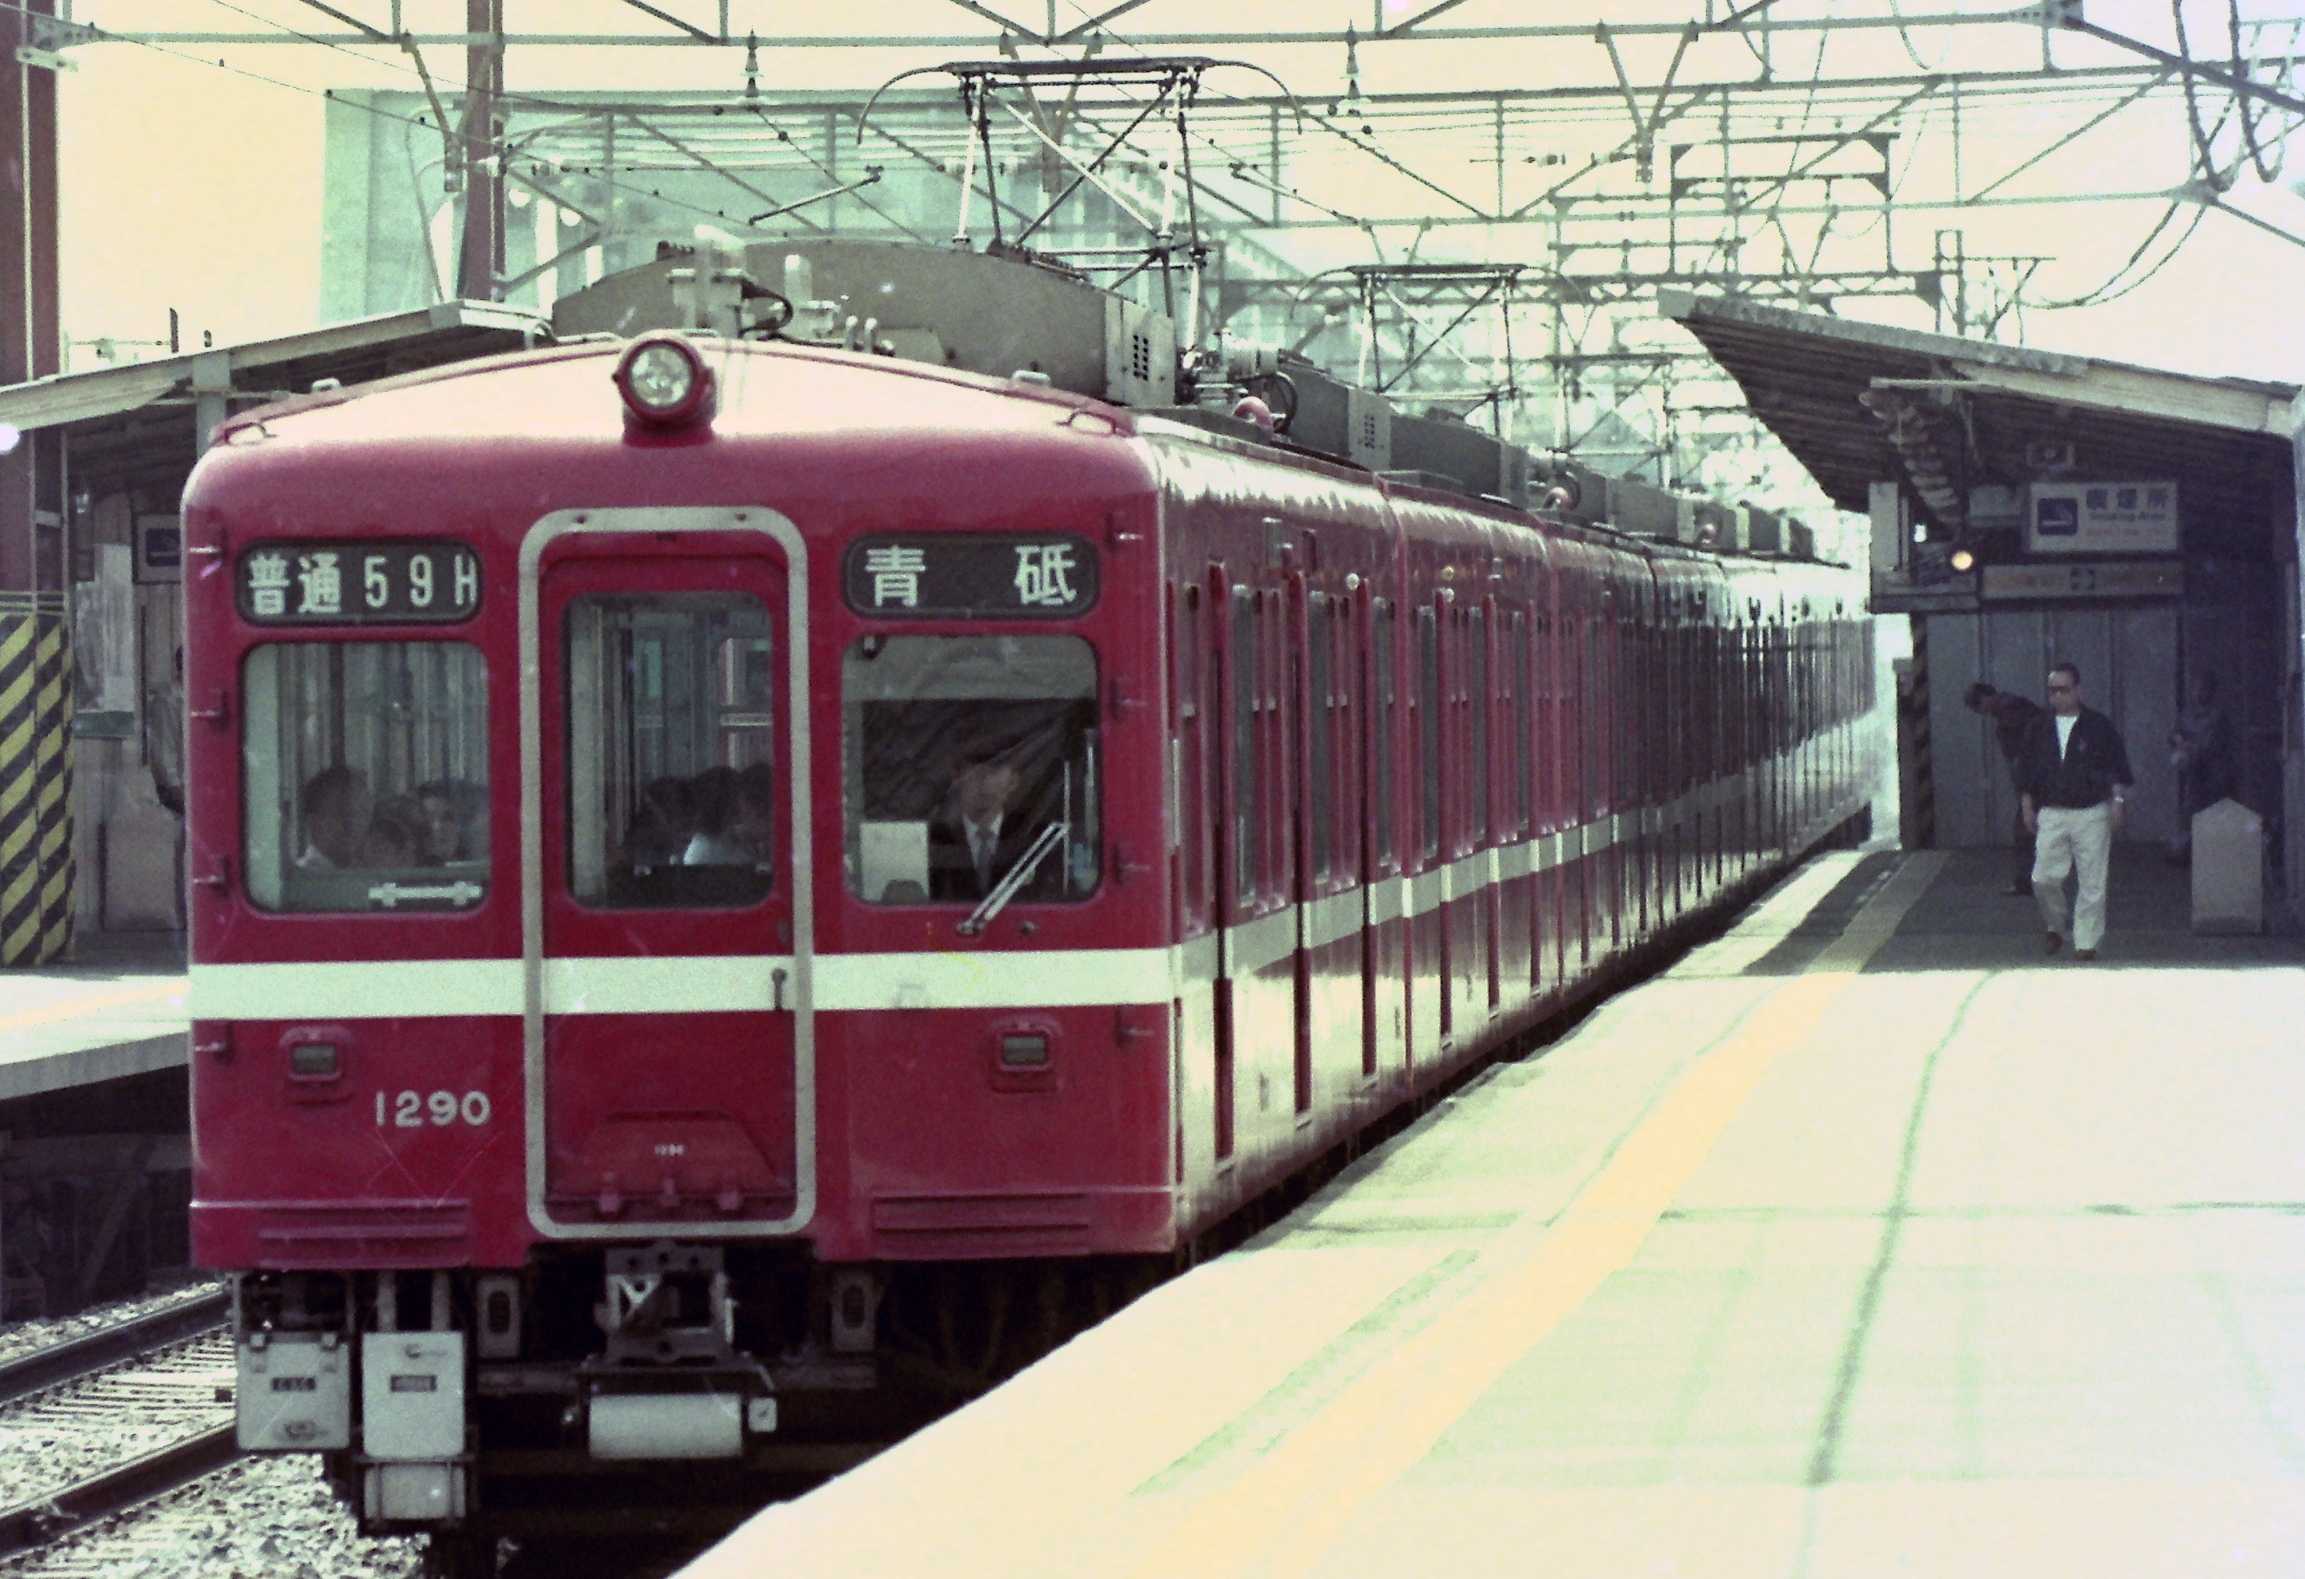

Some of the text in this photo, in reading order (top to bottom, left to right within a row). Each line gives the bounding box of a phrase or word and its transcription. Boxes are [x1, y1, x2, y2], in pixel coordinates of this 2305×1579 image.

[249, 553, 477, 615] 普通 59H
[376, 1090, 491, 1127] 1290
